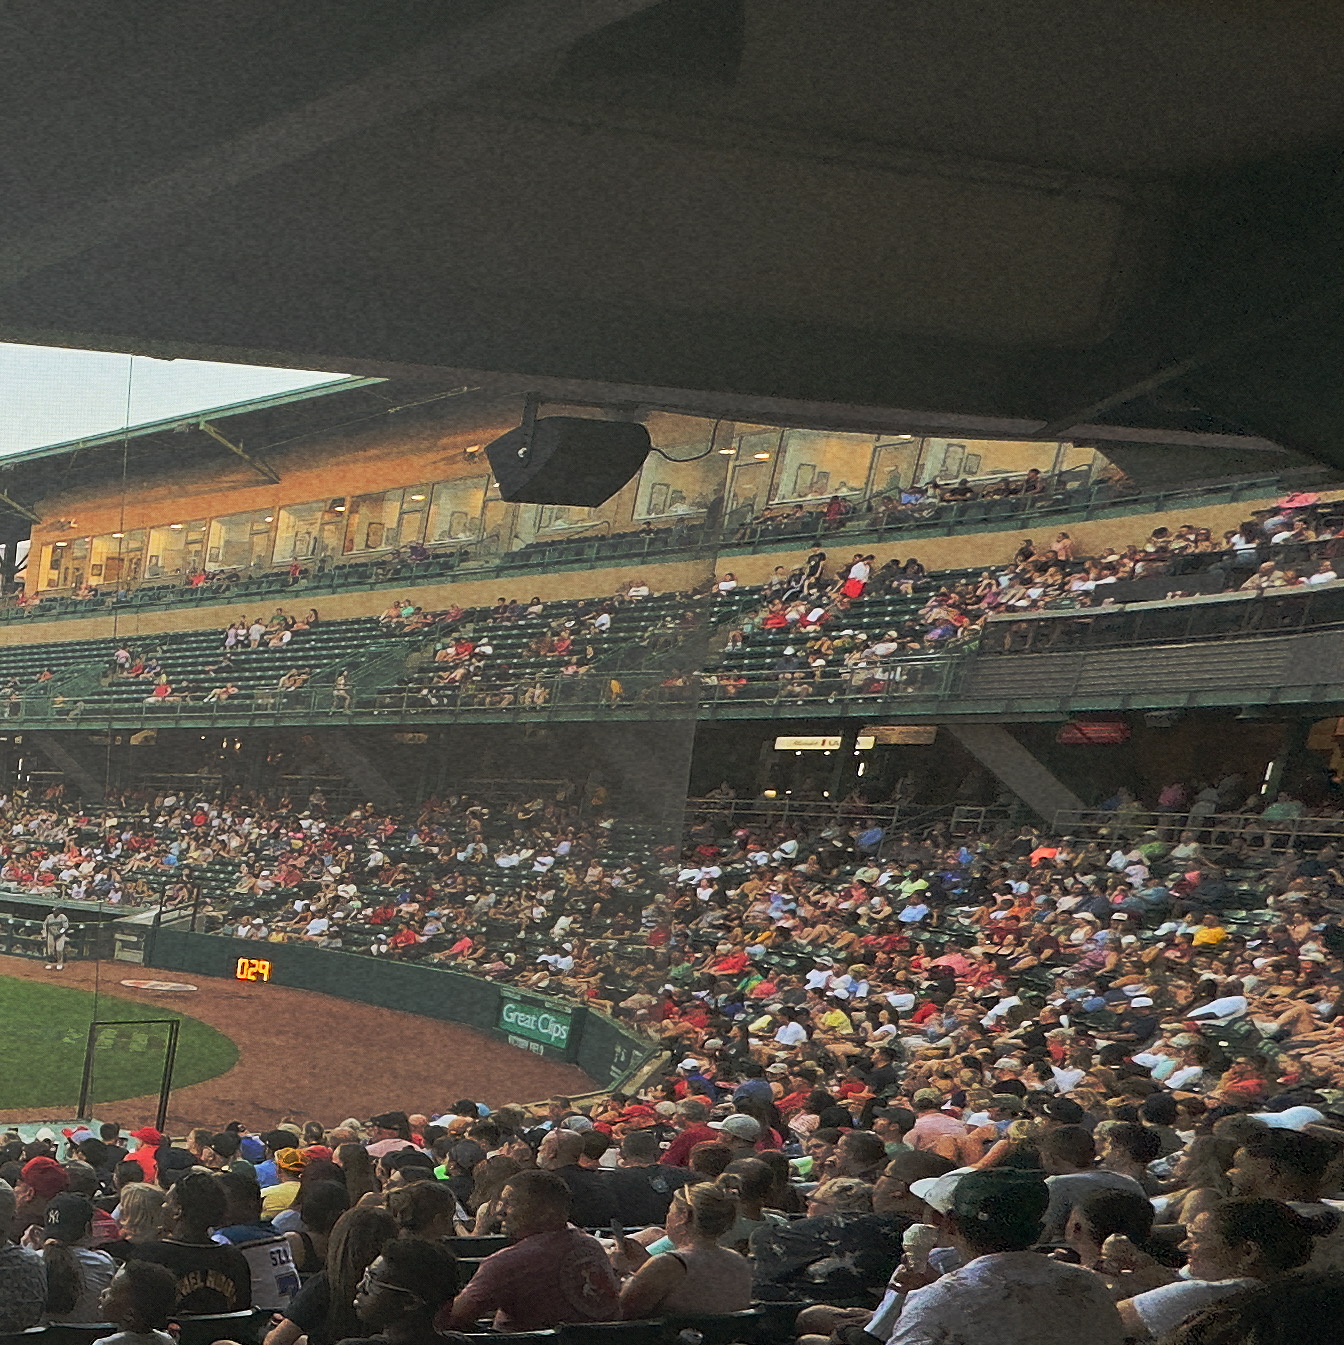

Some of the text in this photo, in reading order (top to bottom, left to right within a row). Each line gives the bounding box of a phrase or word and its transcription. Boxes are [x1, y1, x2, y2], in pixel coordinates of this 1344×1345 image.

[237, 958, 269, 982] 029
[502, 1004, 570, 1041] Great Clips
